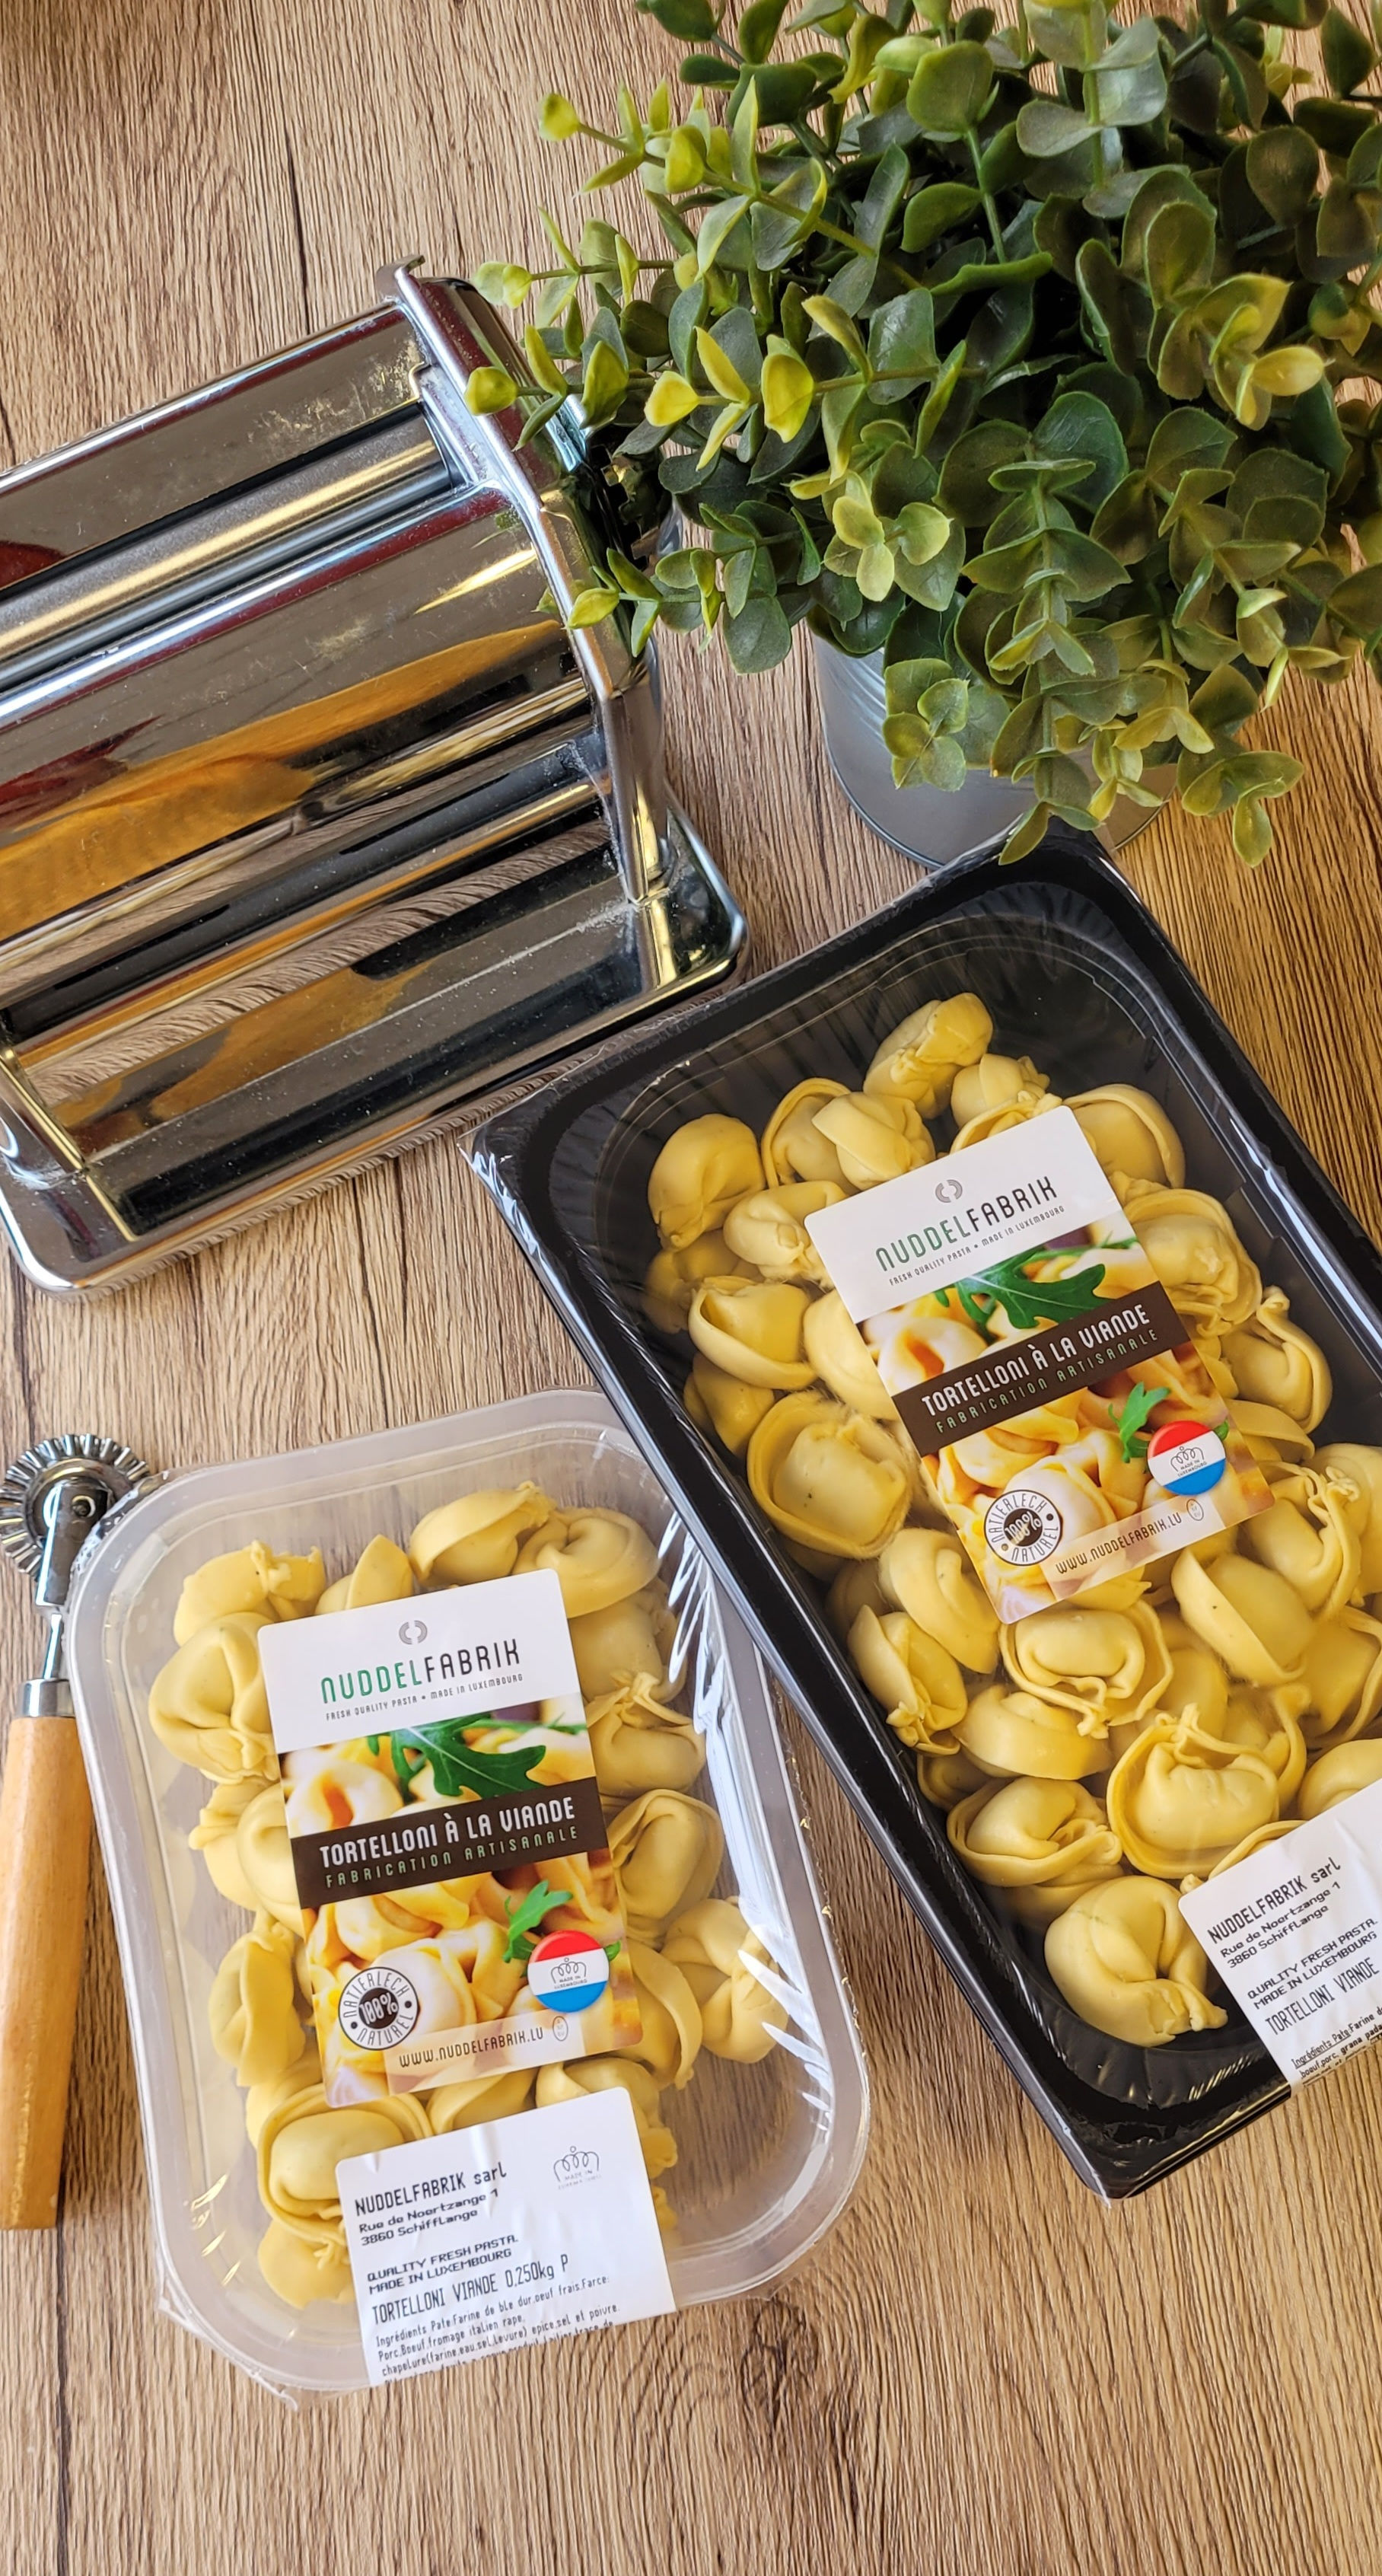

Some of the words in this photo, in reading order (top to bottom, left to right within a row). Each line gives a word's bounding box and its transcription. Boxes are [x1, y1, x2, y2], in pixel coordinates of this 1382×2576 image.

[875, 1176, 1057, 1271] NUDDELFABRIK
[889, 1270, 912, 1286] FRESH
[914, 1257, 946, 1276] QUALITY
[947, 1246, 971, 1262] PASTA
[982, 1232, 1004, 1246] MADE
[1006, 1226, 1014, 1236] IN
[1015, 1205, 1065, 1232] LUXEMBOURG
[922, 1357, 1030, 1416] TORTELLONI
[1027, 1344, 1049, 1370] À
[1049, 1337, 1077, 1362] LA
[1078, 1304, 1150, 1349] VIANDE
[936, 1379, 1048, 1433] FABRICATION
[1057, 1329, 1158, 1382] ARTISANALE
[989, 1493, 1048, 1543] NATIERLECH
[1005, 1511, 1041, 1545] 100%
[1011, 1526, 1059, 1562] NATUREL
[1055, 1512, 1183, 1574] WWW.NUDDELFABRIK.LU
[320, 1638, 520, 1704] NUDDELFABRIK
[326, 1708, 351, 1721] FRESH
[355, 1701, 388, 1716] QUALITY
[392, 1695, 417, 1707] PASTA
[431, 1688, 454, 1699] MADE
[457, 1685, 465, 1694] IN
[468, 1673, 523, 1691] LUXEMBOURG
[320, 1824, 438, 1868] TORTELLONI
[444, 1812, 459, 1843] À
[466, 1813, 492, 1839] LA
[499, 1797, 575, 1832] VIANDE
[326, 1851, 451, 1888] FABRICATION
[464, 1825, 578, 1861] ARTISANALE
[1207, 1876, 1308, 1944] NUDDELFABRIK
[1310, 1857, 1341, 1883] sarl
[1220, 1942, 1244, 1959] Rue
[1246, 1931, 1261, 1943] de
[1261, 1889, 1331, 1934] Noertzange
[1333, 1881, 1341, 1889] 1
[1227, 1947, 1256, 1969] 3860
[1247, 1963, 1298, 1999] QUALITY
[1301, 1940, 1338, 1967] FRESH
[1253, 1985, 1288, 2010] MADE
[1287, 1976, 1303, 1990] IN
[1302, 1930, 1377, 1980] LUXEMBOURG
[343, 1970, 410, 2018] NATIERLECH
[359, 1992, 400, 2025] 100%
[1265, 1984, 1336, 2036] TORTELLONI
[1333, 1957, 1380, 1993] VIANDE
[357, 2014, 413, 2045] NATUREL
[400, 2026, 543, 2068] WWW.NUDDELFABRIK.LU
[1340, 2037, 1363, 2055] grana
[355, 2171, 467, 2217] NUDDELFABRIK
[474, 2162, 507, 2185] sarl
[358, 2221, 384, 2233] Rue
[387, 2215, 403, 2226] de
[407, 2194, 486, 2221] Noertzange
[490, 2189, 498, 2198] 1
[361, 2230, 394, 2246] 3860
[368, 2258, 426, 2282] QUALITY
[430, 2247, 472, 2265] FRESH
[369, 2278, 405, 2295] MADE
[409, 2272, 424, 2284] IN
[427, 2248, 512, 2279] LUXEMBOURG
[372, 2287, 445, 2325] TORTELLONI
[452, 2273, 498, 2302] VIANDE
[560, 2253, 568, 2272] P
[470, 2322, 498, 2336] italien
[485, 2304, 495, 2316] de
[575, 2310, 584, 2323] et
